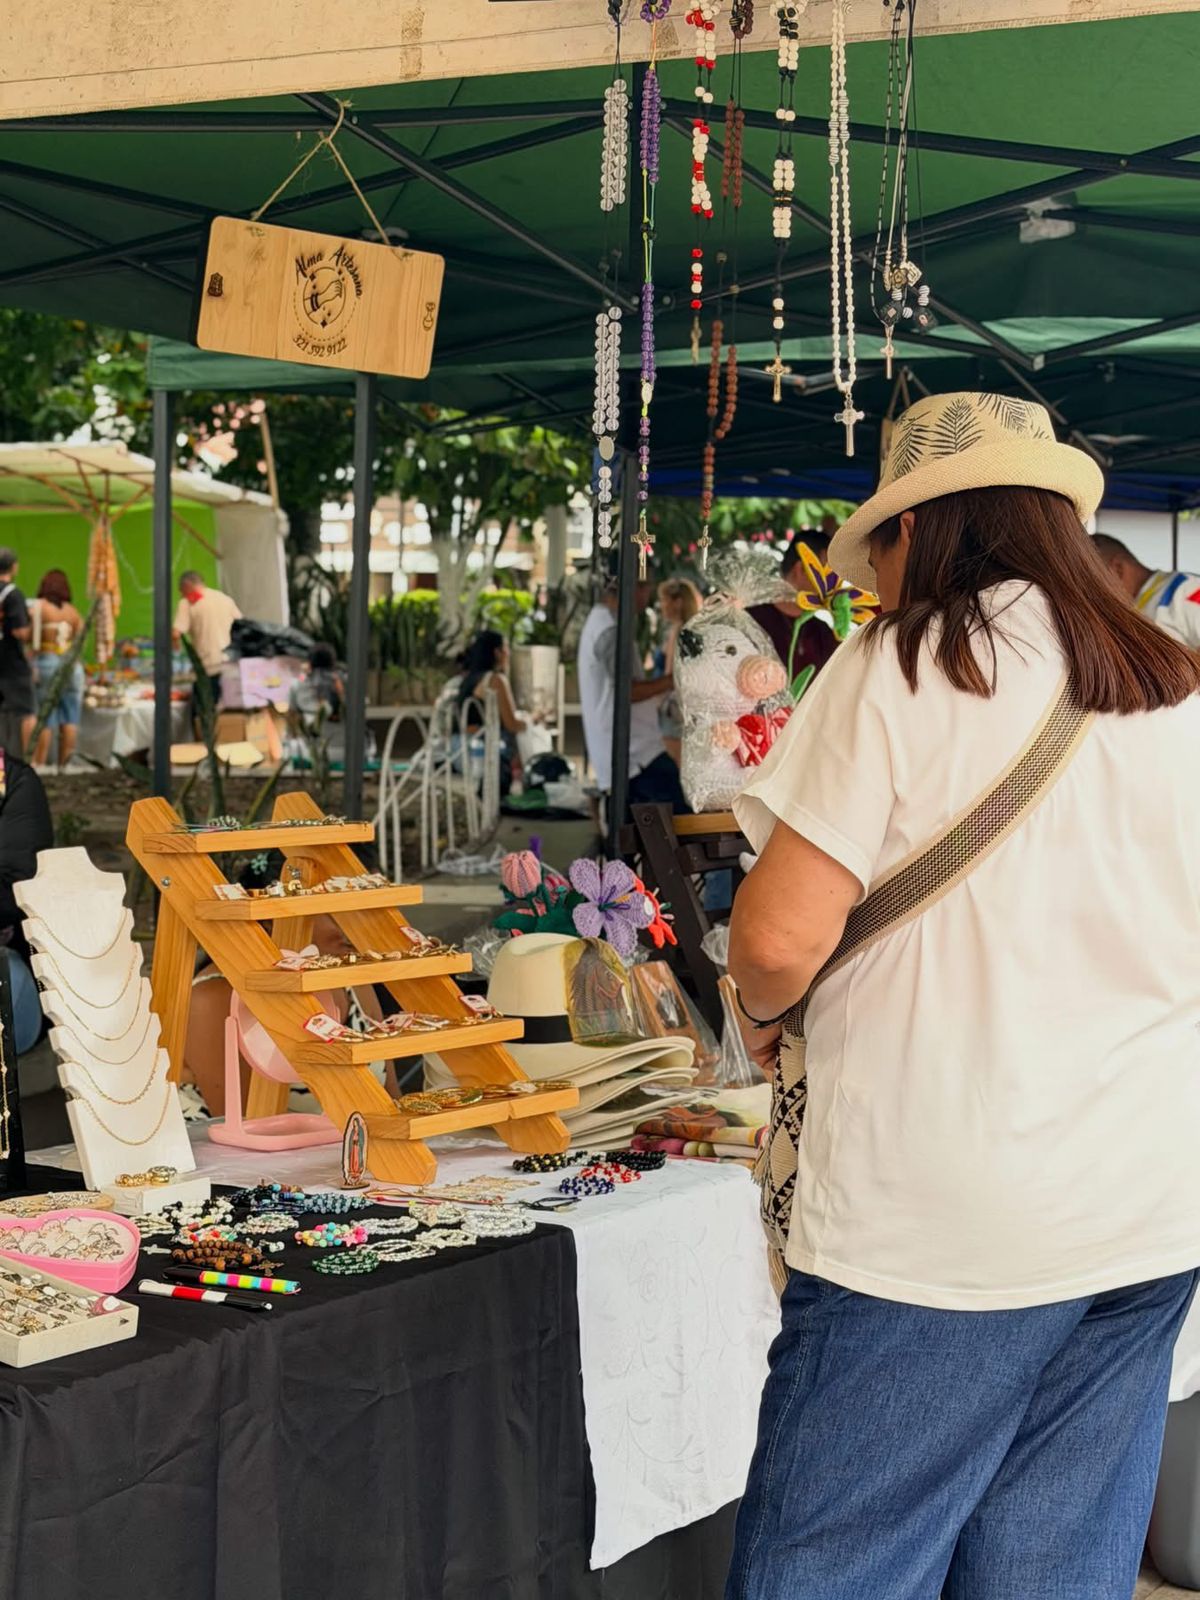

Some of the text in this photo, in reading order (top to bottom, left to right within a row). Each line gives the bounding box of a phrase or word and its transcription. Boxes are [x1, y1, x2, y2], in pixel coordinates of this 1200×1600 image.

[295, 244, 363, 300] Alma Artesana
[292, 334, 348, 358] 321 592 9122
